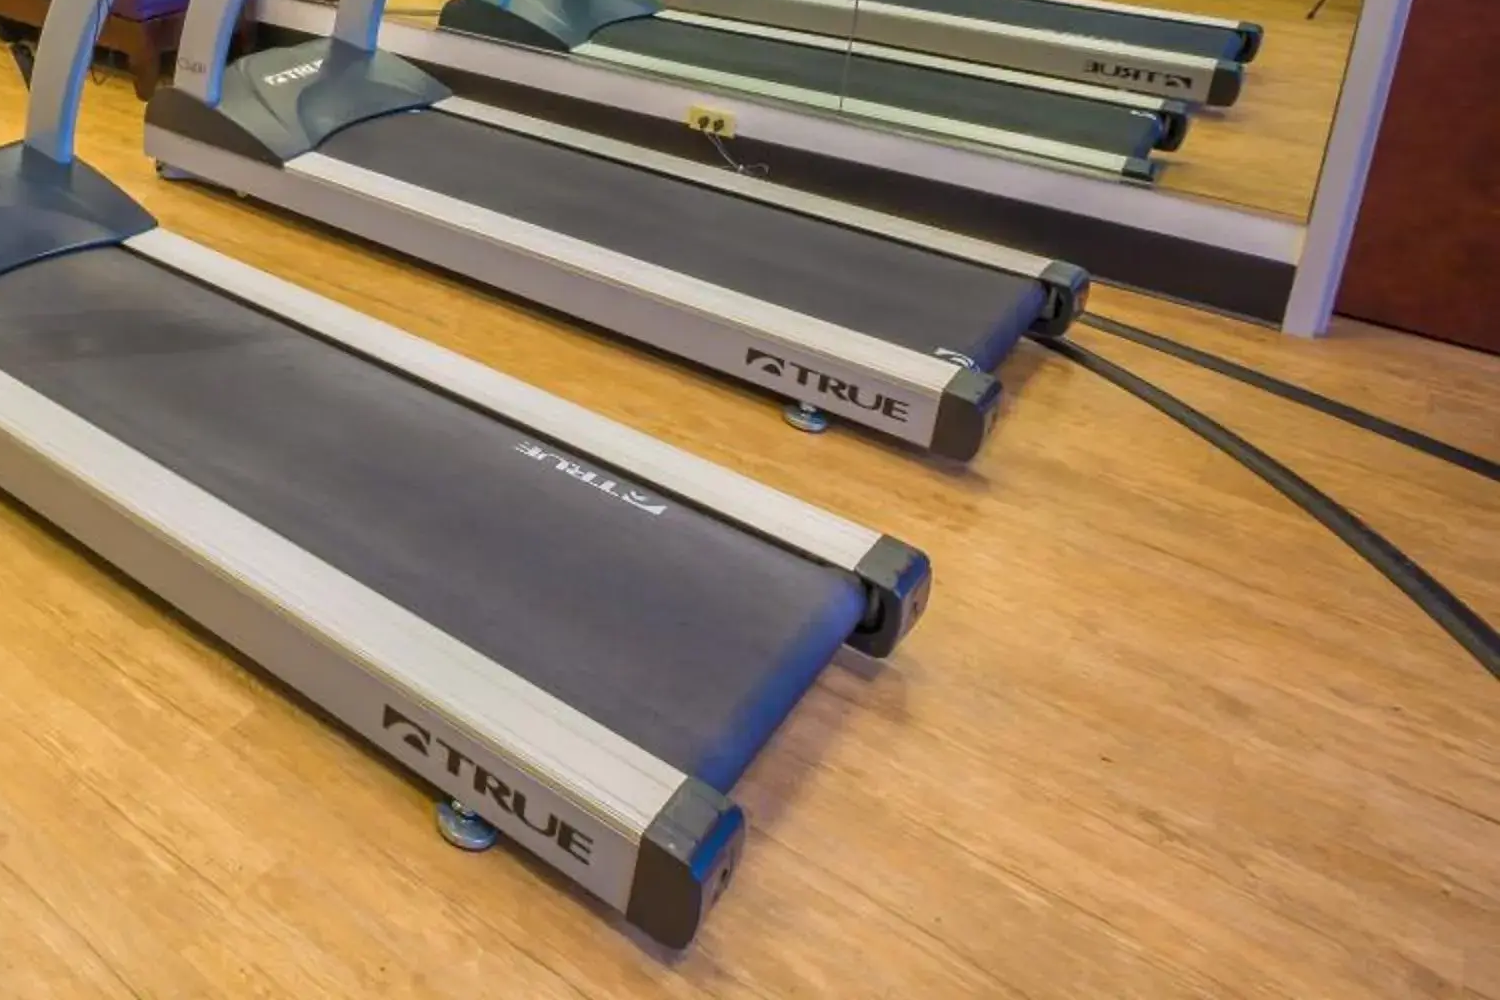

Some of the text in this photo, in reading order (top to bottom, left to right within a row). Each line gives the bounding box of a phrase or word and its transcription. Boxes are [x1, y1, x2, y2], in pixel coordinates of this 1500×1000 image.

[790, 362, 910, 423] TRUE
[515, 441, 621, 498] TRUE
[435, 737, 594, 866] TRUE
